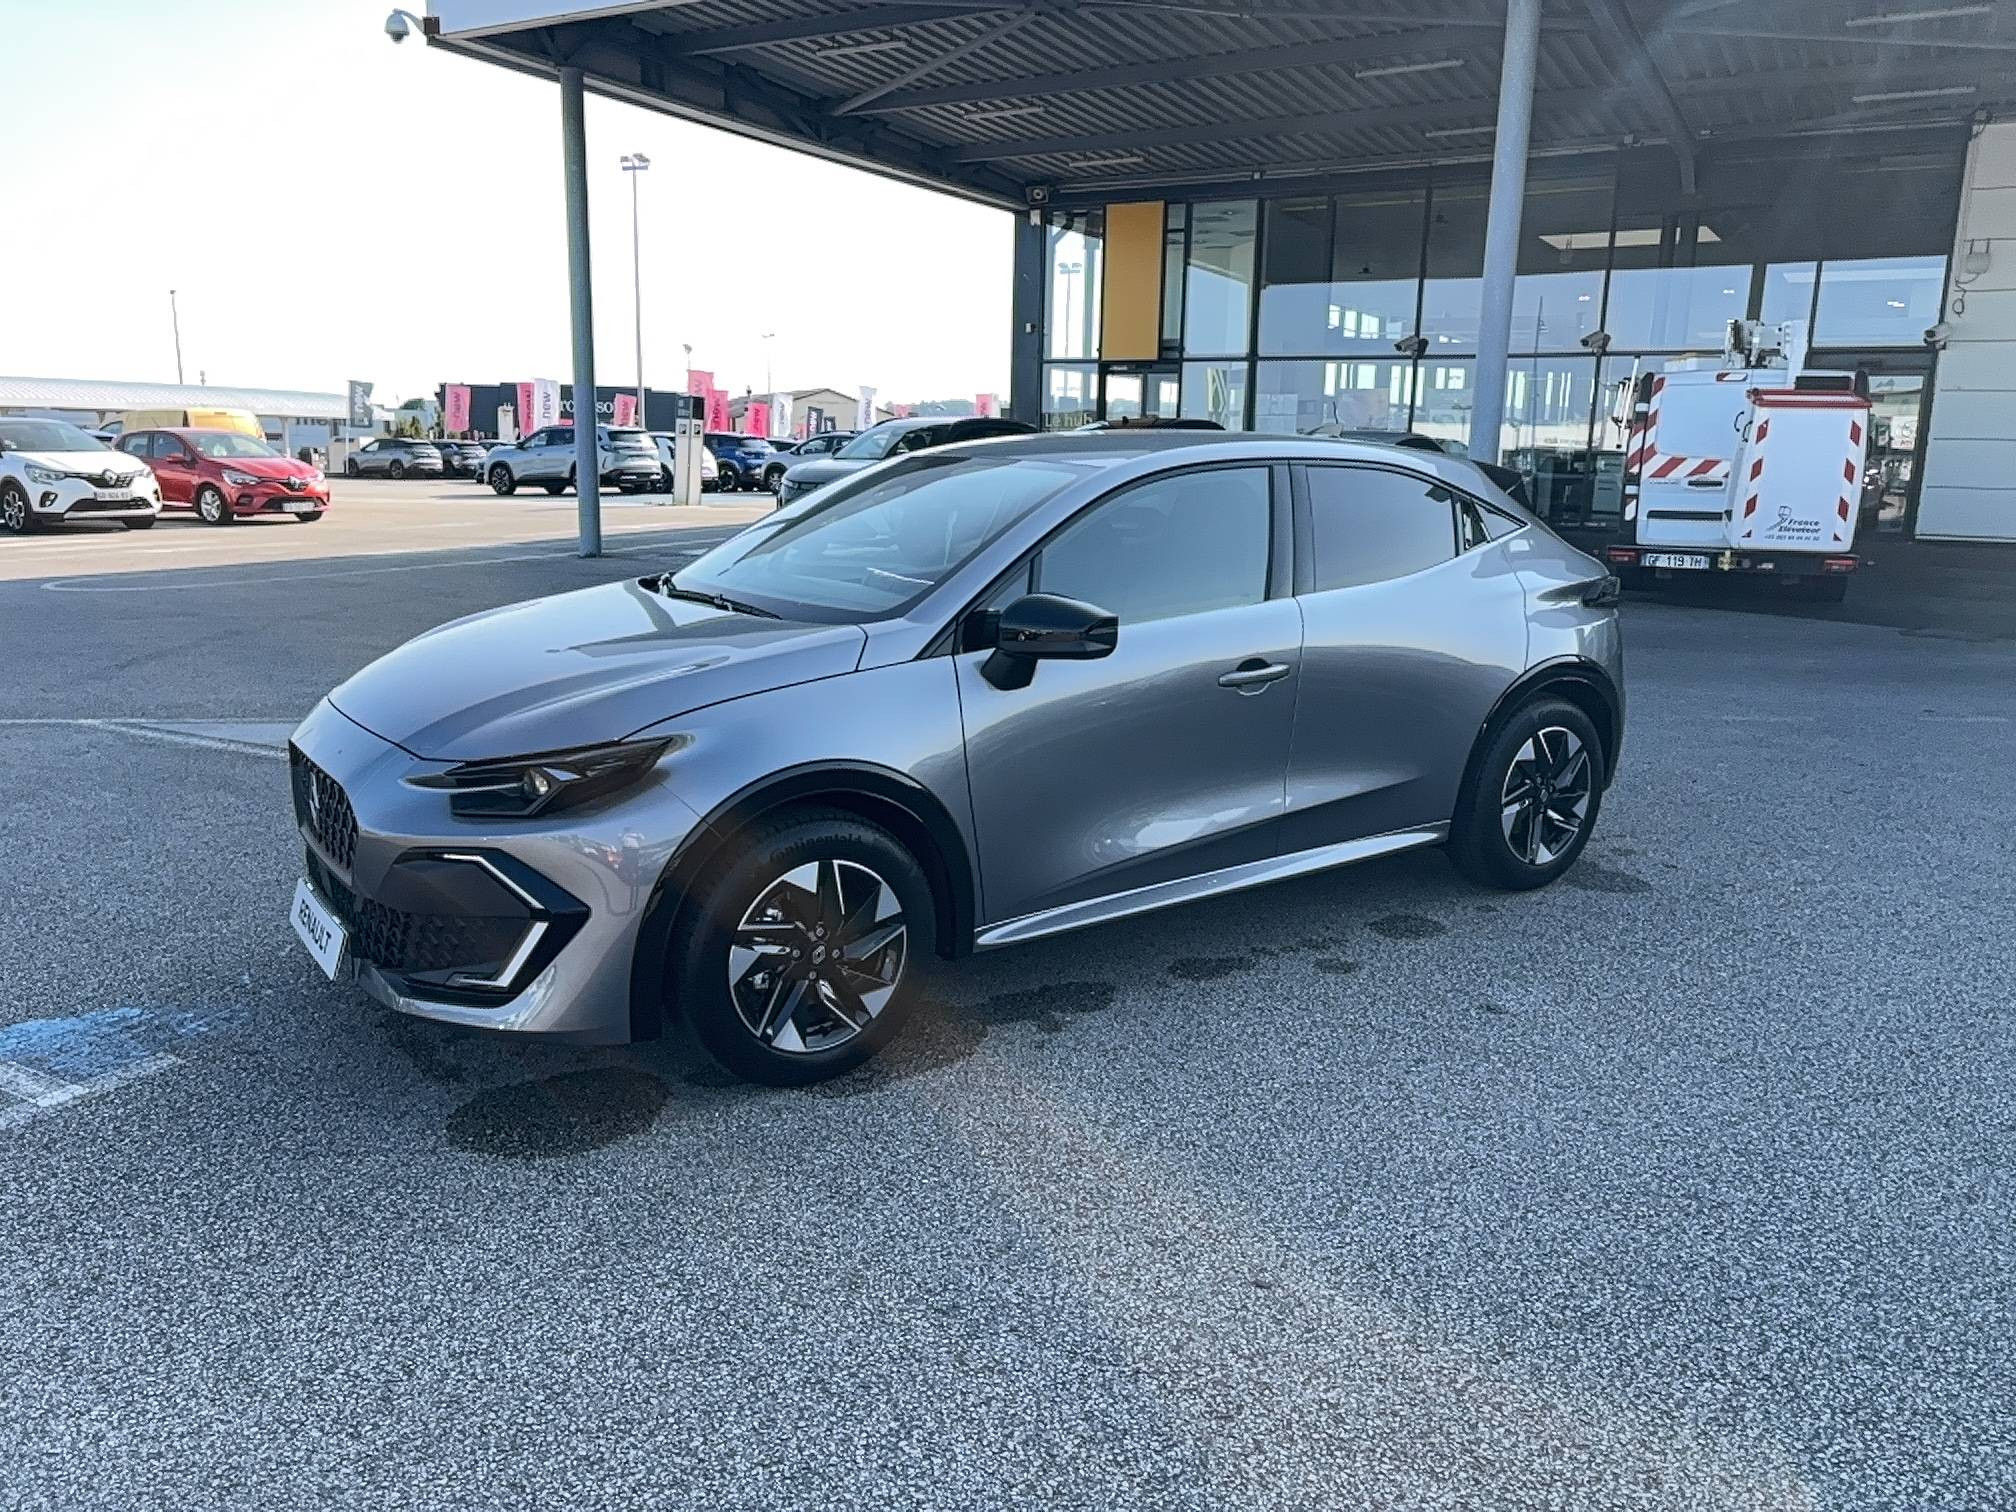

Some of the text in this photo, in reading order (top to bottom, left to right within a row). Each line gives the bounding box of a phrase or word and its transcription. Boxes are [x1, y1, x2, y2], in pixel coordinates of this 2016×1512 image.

[452, 391, 461, 419] new
[542, 391, 551, 419] new
[1788, 519, 1820, 527] France
[1667, 556, 1684, 567] 119
[299, 898, 331, 954] RENAULT
